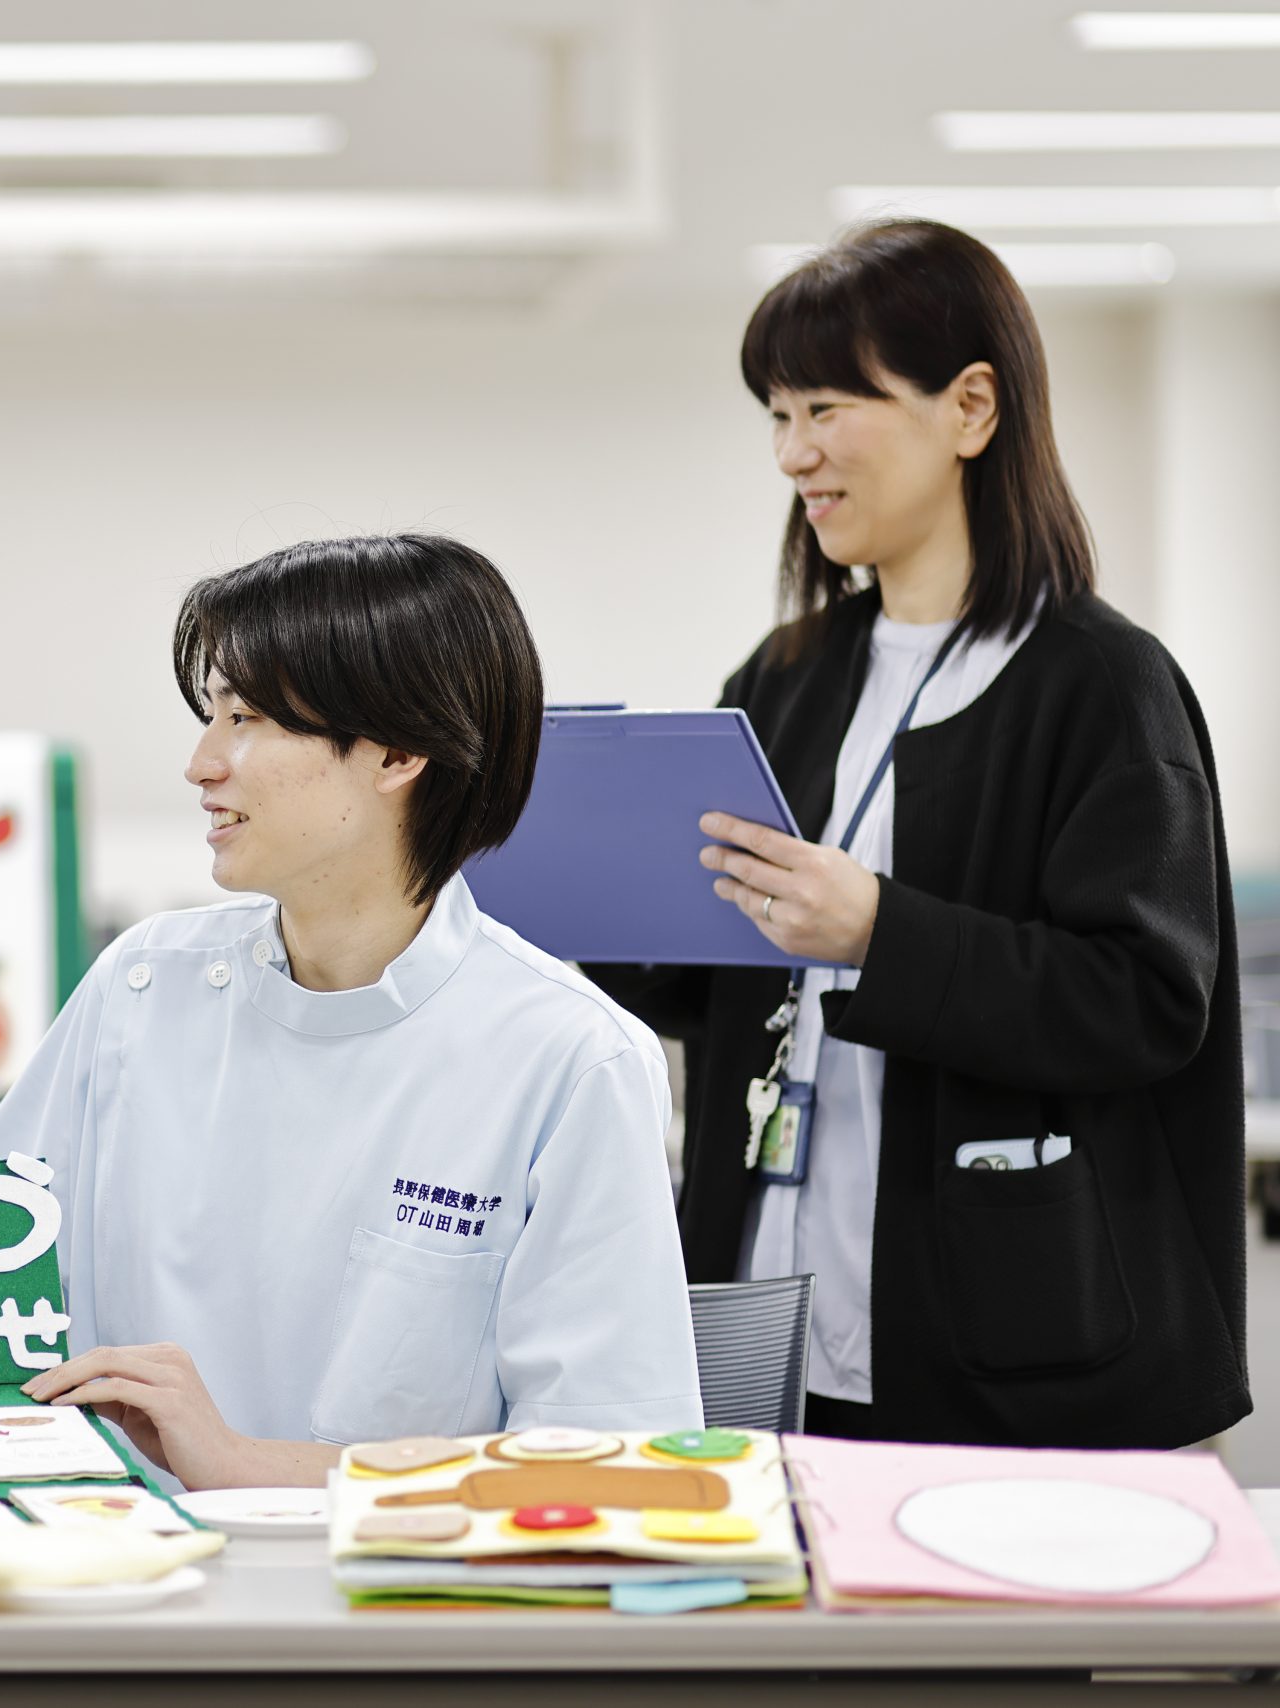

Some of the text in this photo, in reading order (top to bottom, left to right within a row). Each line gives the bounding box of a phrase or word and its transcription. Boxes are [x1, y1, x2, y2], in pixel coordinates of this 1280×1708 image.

[392, 1177, 502, 1213] 長野保健医療大学
